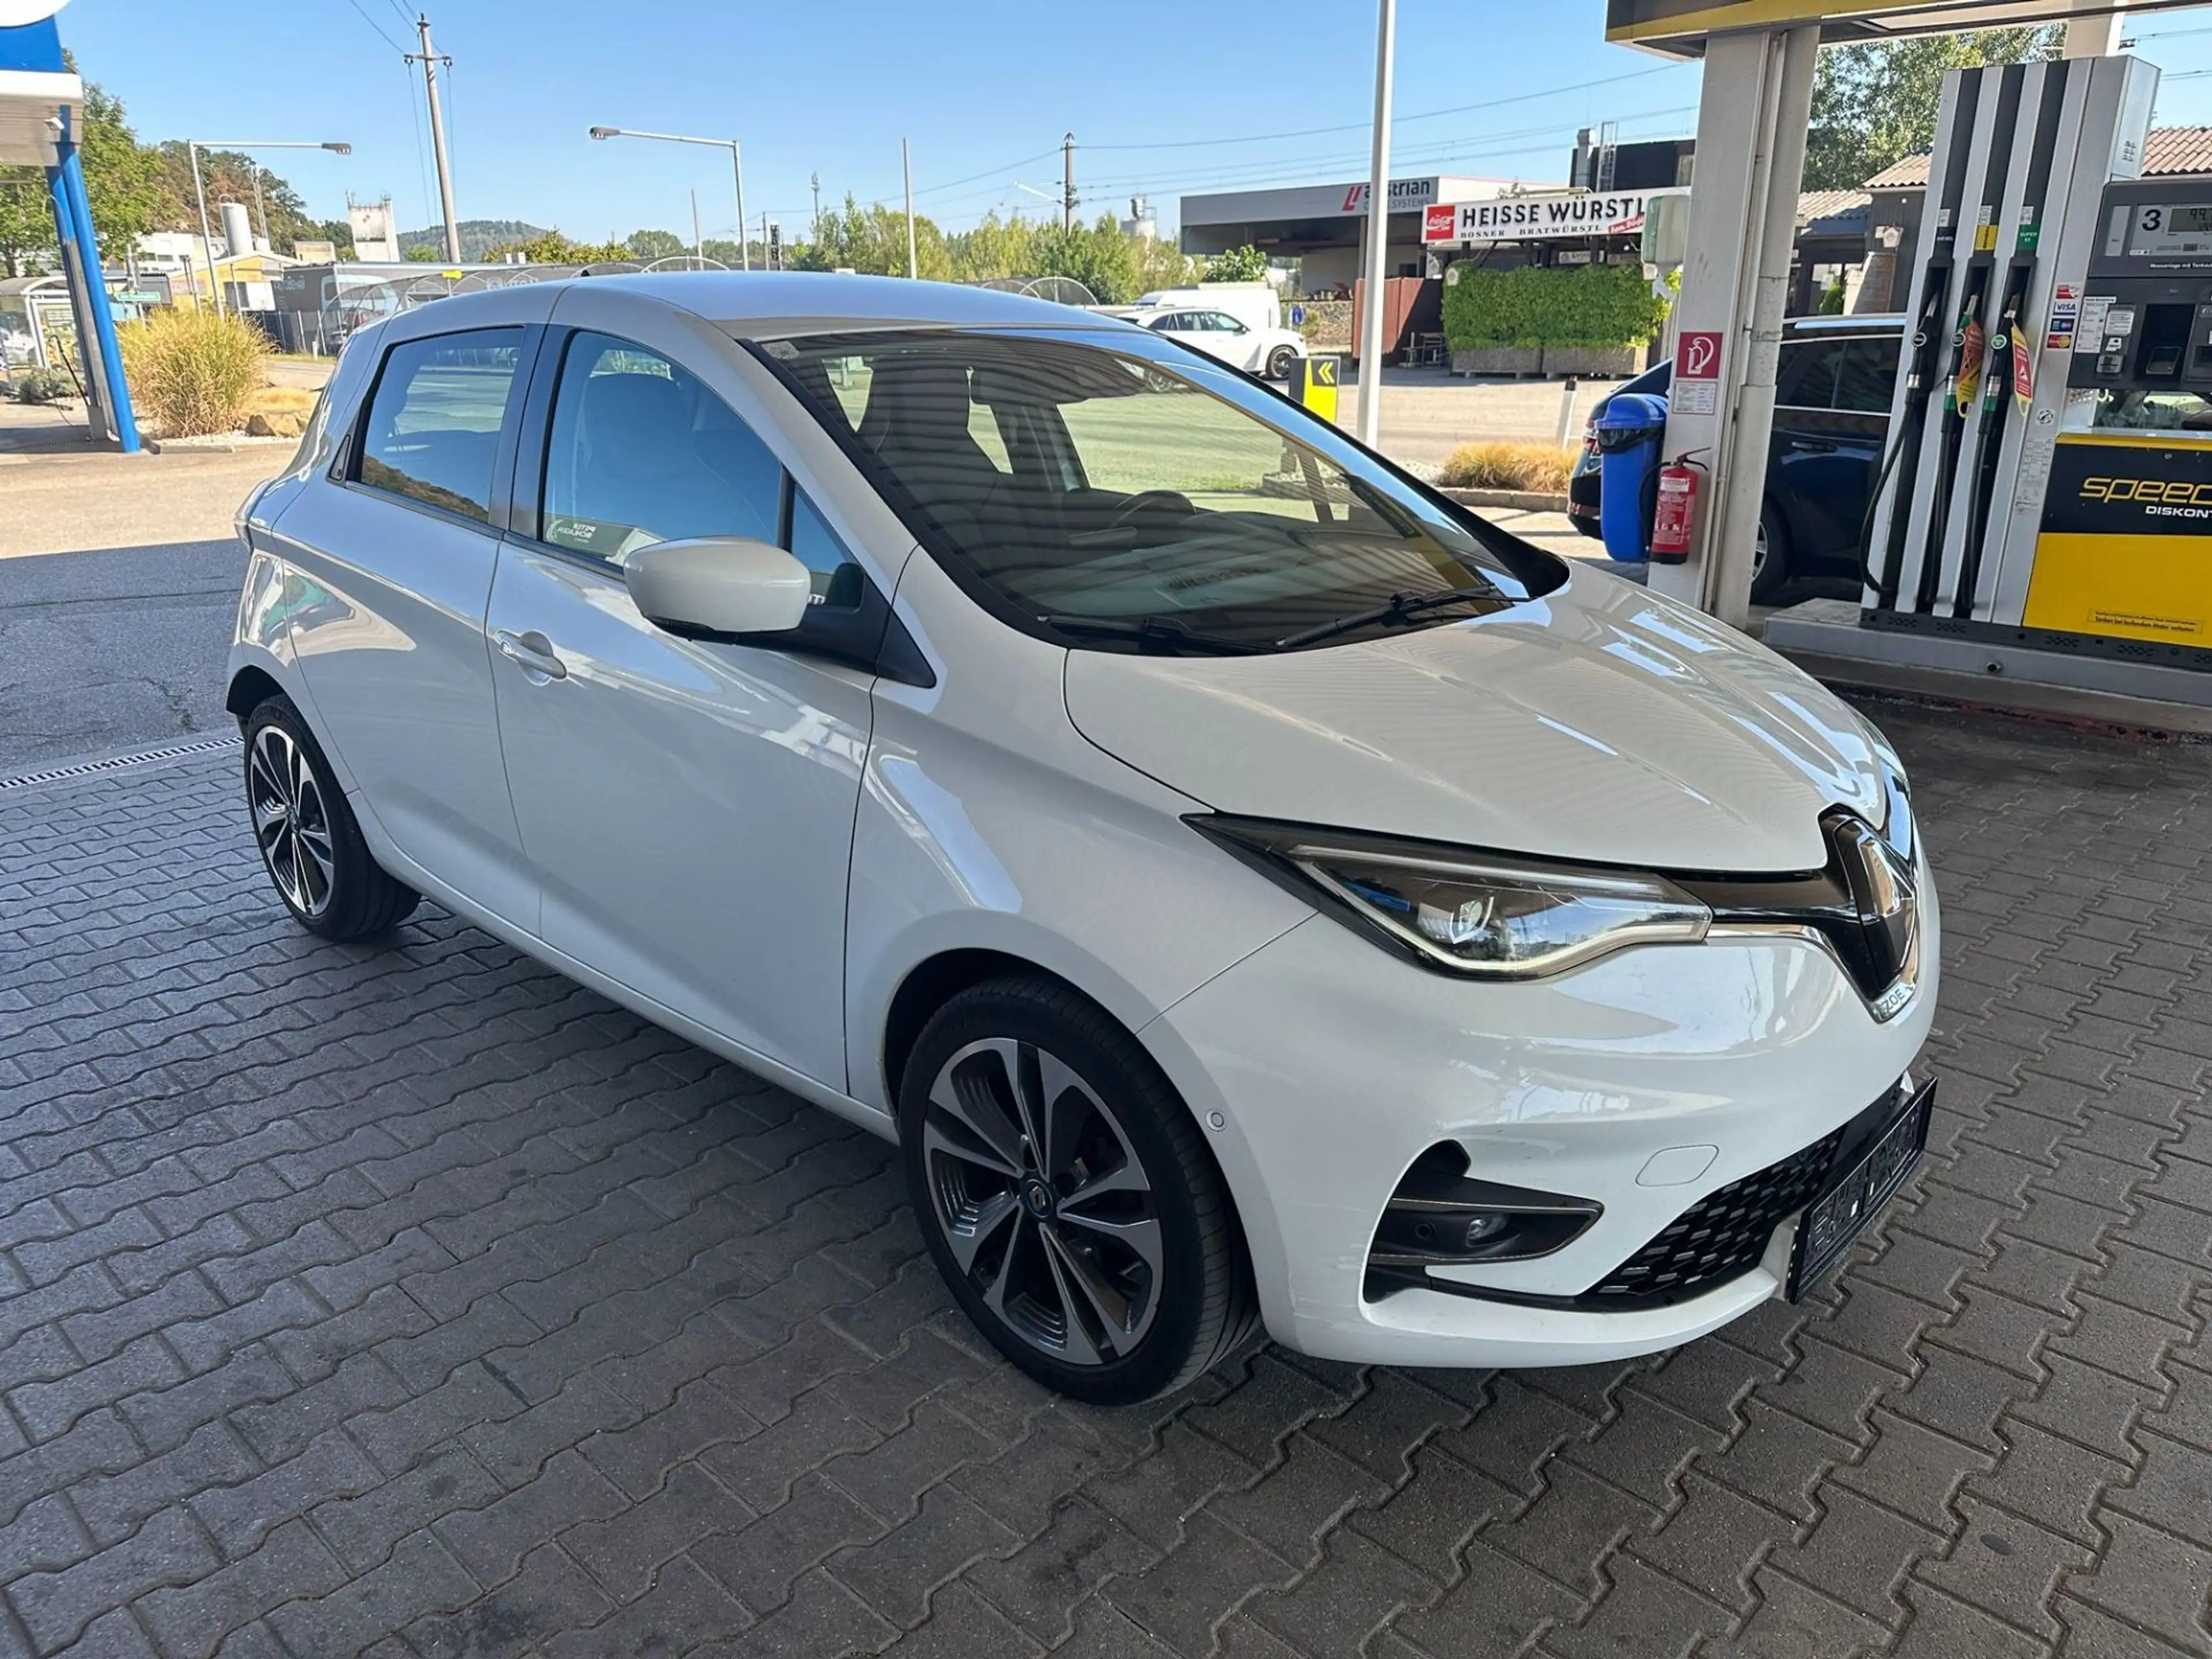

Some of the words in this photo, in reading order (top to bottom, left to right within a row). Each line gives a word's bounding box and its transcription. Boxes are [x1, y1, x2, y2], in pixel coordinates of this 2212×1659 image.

[1364, 180, 1430, 199] astrian
[1463, 203, 1540, 227] HEISSE
[1548, 195, 1645, 223] WÜRSTL
[2142, 209, 2161, 231] 3
[1460, 229, 1505, 238] BOSNER
[1519, 224, 1601, 236] BRATWÜRSTL
[2057, 303, 2076, 311] VISA
[1880, 988, 1906, 1011] ZOE
